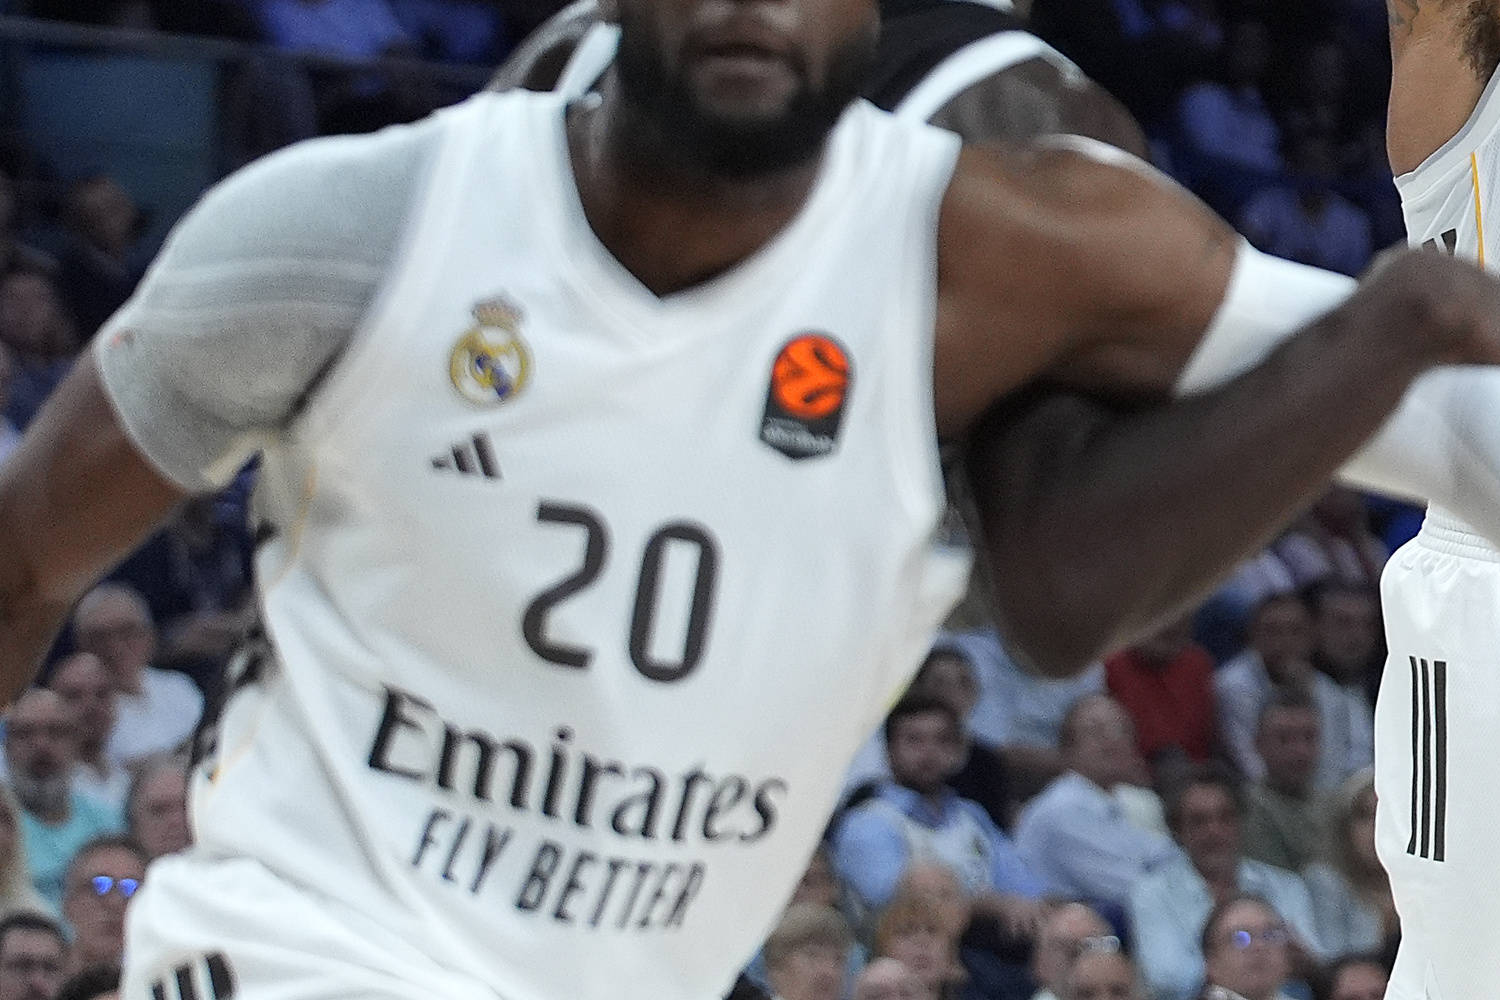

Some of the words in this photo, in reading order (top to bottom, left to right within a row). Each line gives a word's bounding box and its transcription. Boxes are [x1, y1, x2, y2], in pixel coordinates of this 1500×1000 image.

[520, 500, 724, 685] 20
[368, 682, 789, 845] Emirates
[411, 806, 516, 895] FLY
[514, 838, 708, 930] BETTER
